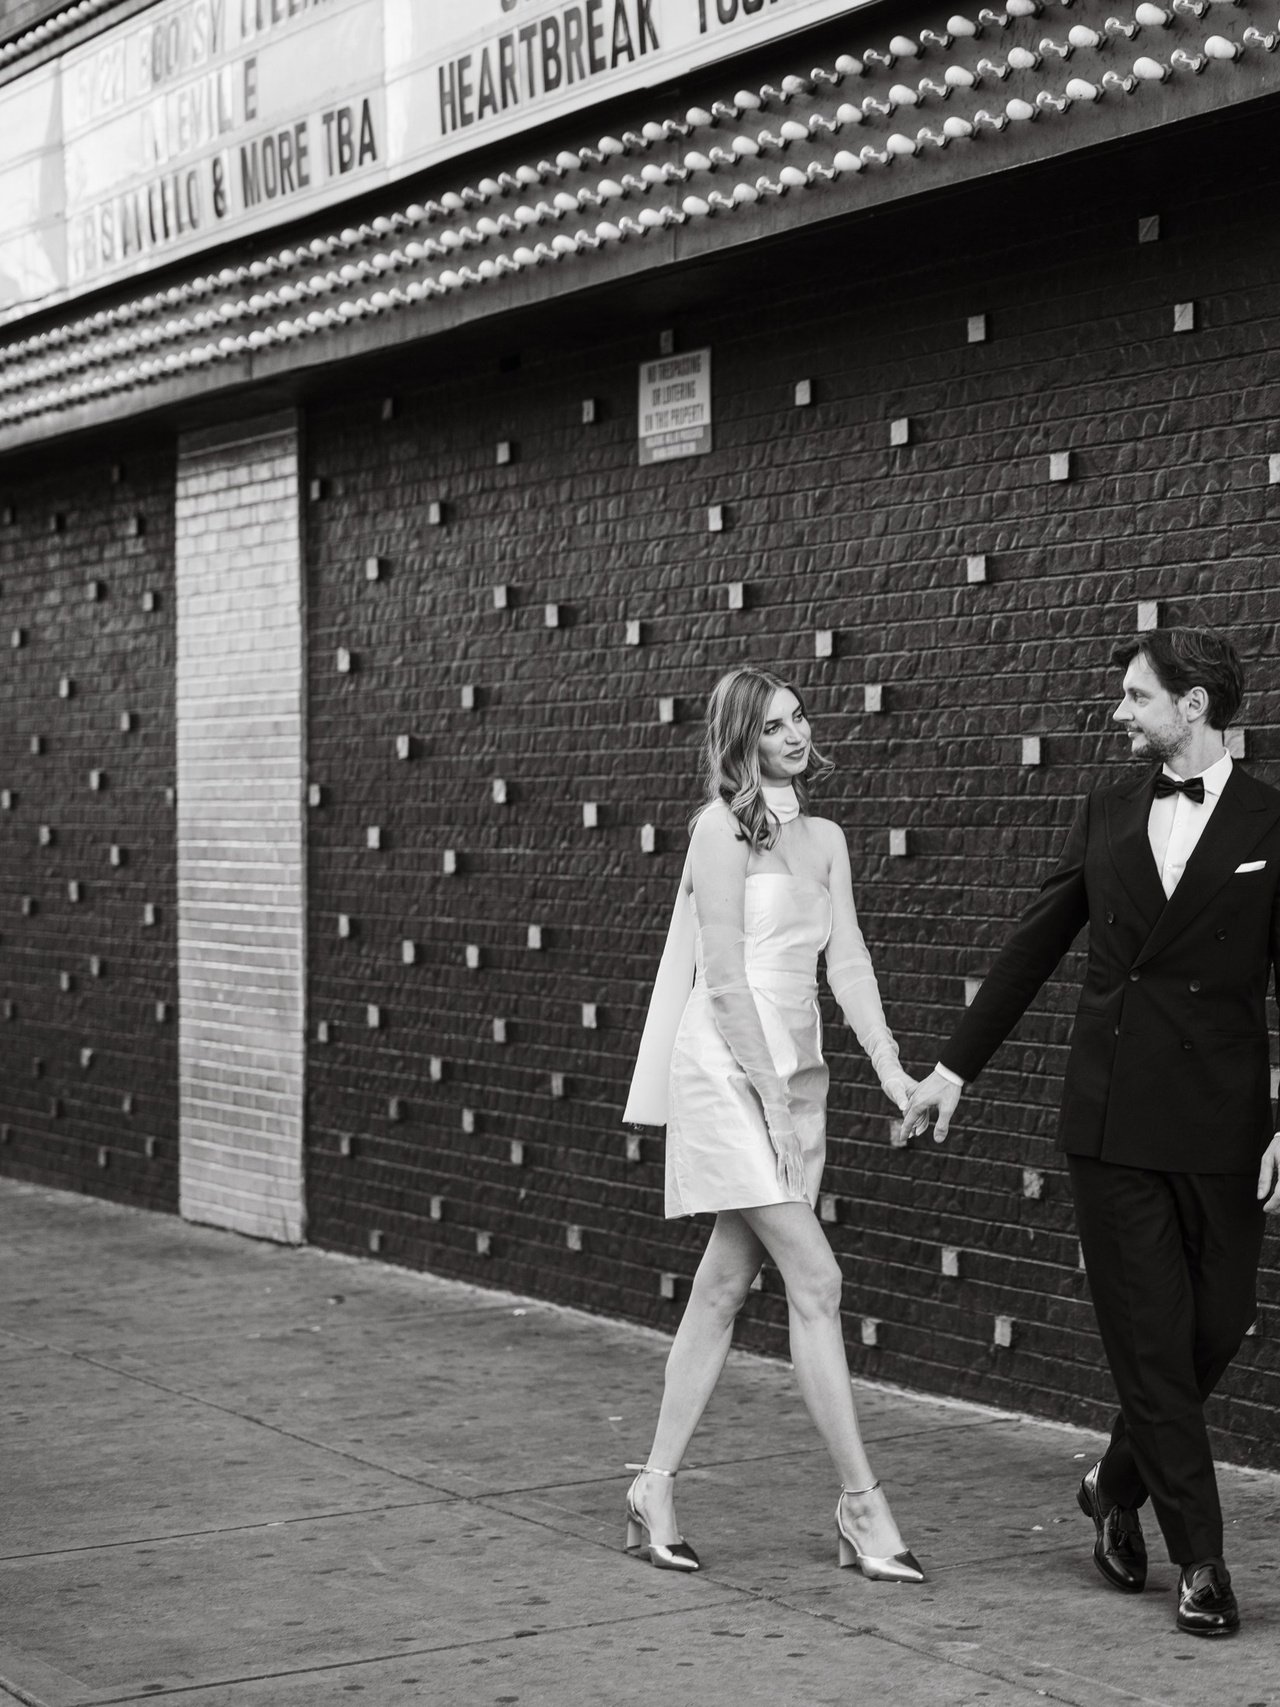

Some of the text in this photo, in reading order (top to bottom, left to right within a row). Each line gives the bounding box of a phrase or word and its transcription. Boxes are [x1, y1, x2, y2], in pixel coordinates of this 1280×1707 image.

[438, 0, 660, 135] HEARTBREAK
[240, 121, 310, 208] MORE
[322, 98, 377, 176] TBA
[671, 404, 704, 426] PROPERTY
